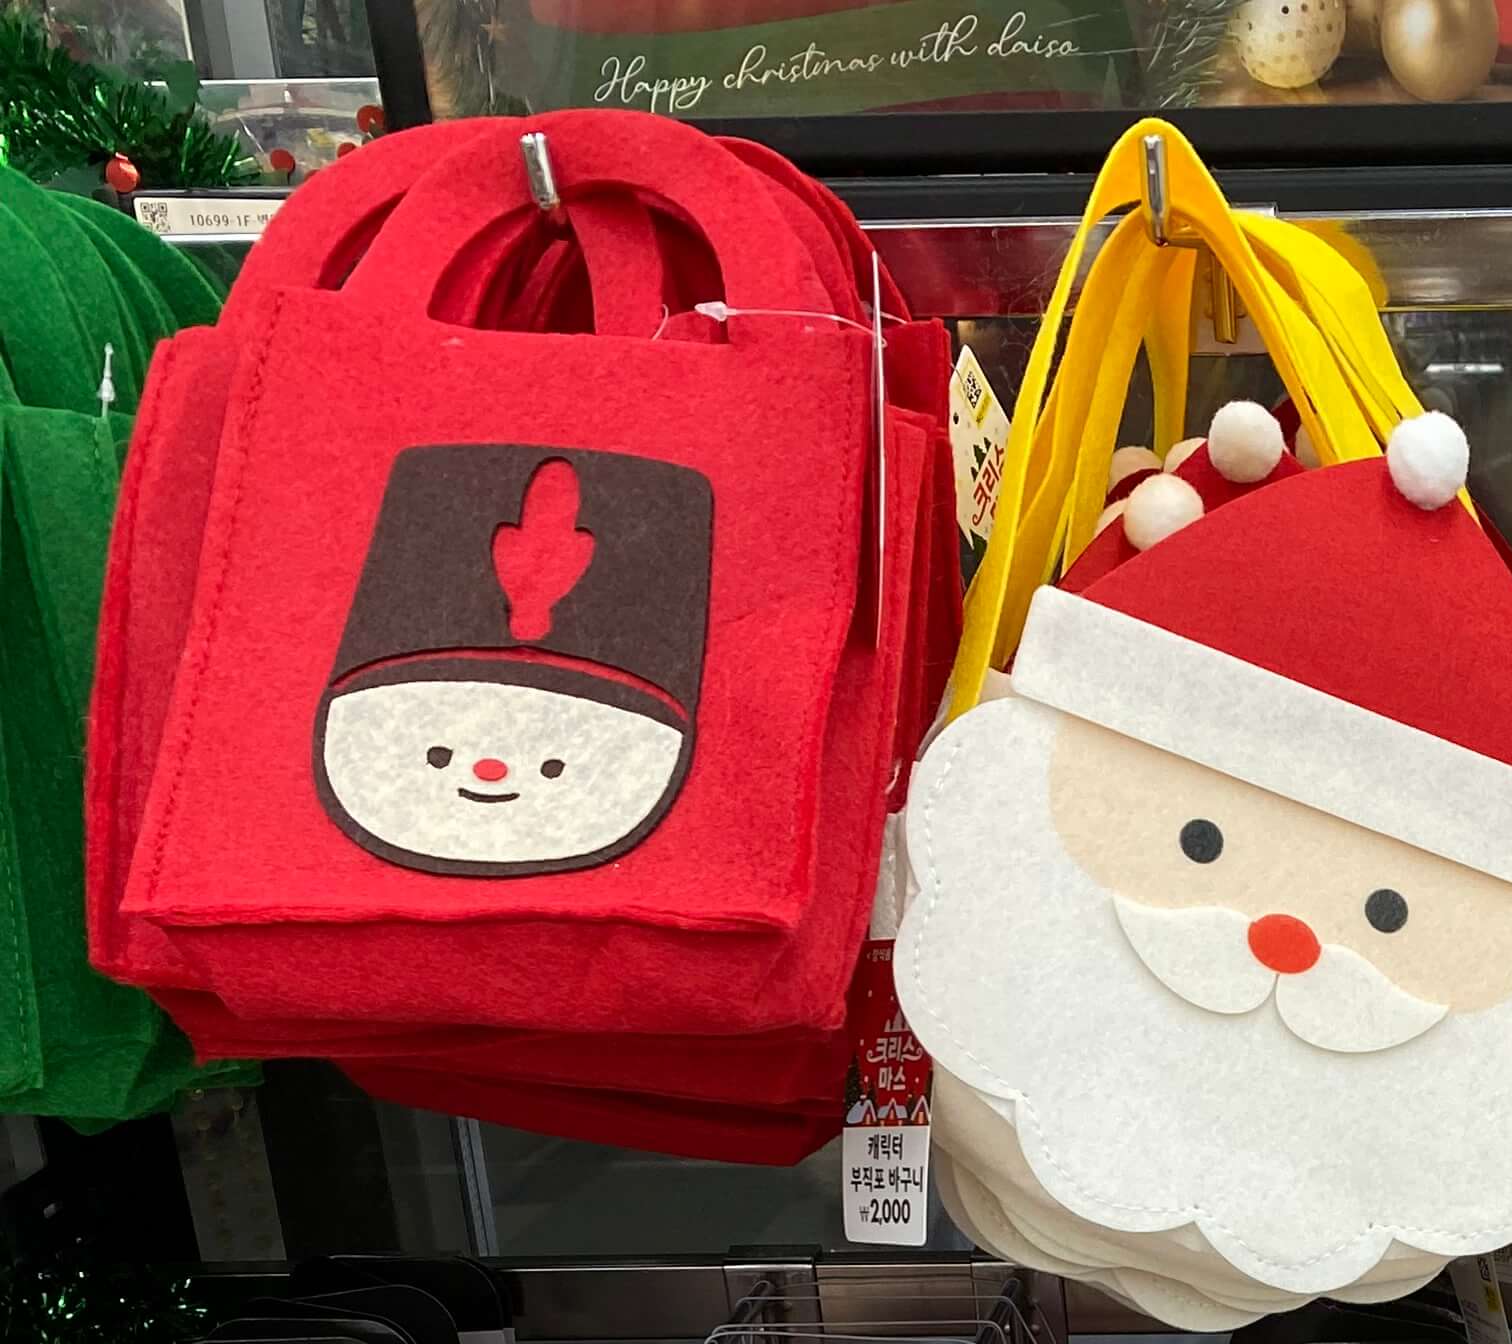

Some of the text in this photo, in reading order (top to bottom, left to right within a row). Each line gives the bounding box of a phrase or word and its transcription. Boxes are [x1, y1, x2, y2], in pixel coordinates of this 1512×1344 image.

[594, 14, 1080, 113] Happy christmas with daiso
[866, 1036, 923, 1063] 크리스
[878, 1065, 906, 1091] 마스
[867, 1133, 903, 1160] 캐릭터
[850, 1166, 924, 1193] 부직포 바구니
[859, 1198, 911, 1226] ₩2,000
